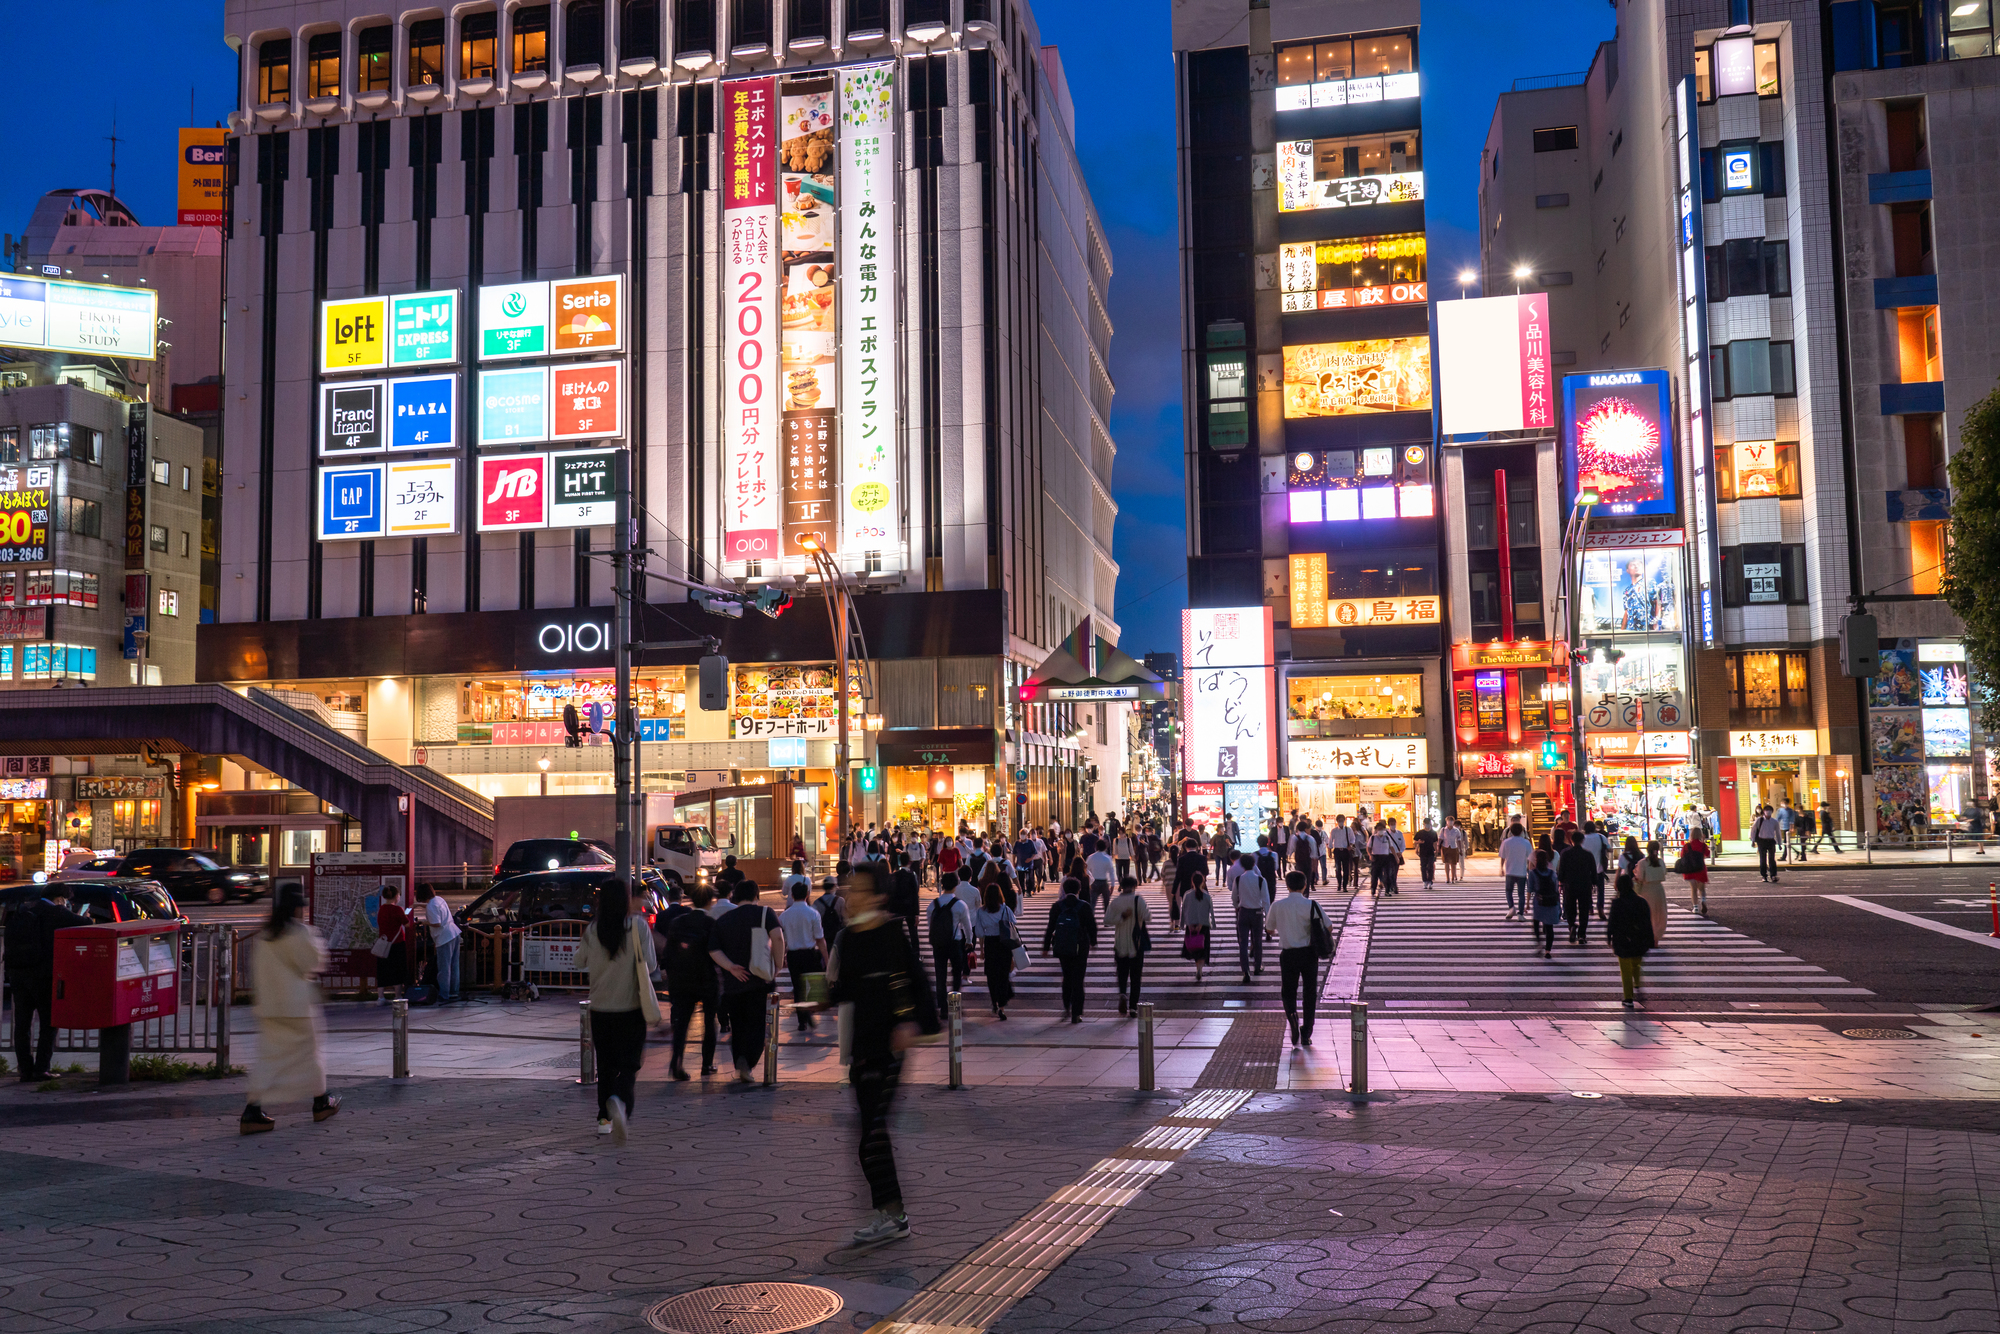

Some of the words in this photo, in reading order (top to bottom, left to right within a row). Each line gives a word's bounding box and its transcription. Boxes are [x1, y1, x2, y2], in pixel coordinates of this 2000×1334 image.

[733, 90, 750, 200] 年会費永年無料
[751, 89, 766, 198] エポスカード
[871, 137, 880, 155] 自然
[1296, 142, 1312, 152] 7F
[854, 138, 863, 168] 暮らす
[863, 137, 872, 197] エネルギーで
[731, 216, 743, 265] つかえる
[744, 215, 756, 266] 今日から
[757, 215, 769, 264] ご入会で
[859, 201, 878, 303] みんな電力
[562, 291, 611, 310] Seria
[79, 311, 122, 324] EIKOH
[397, 303, 450, 329] ニトリ
[78, 334, 121, 347] STUDY
[397, 330, 449, 347] EXPRESS
[496, 329, 532, 340] りそな銀行
[578, 333, 594, 345] 7F
[507, 339, 521, 351] 3F
[348, 353, 361, 363] 5F
[416, 347, 430, 358] 8F
[737, 271, 763, 445] 2000円分
[860, 316, 879, 439] エポスプラン
[1525, 323, 1548, 425] 品川美容外科
[1590, 373, 1642, 387] NAGATA
[562, 381, 610, 395] ほけんの
[485, 393, 541, 409] @cosme
[334, 408, 373, 421] Franc
[398, 402, 447, 416] PLAZA
[505, 424, 520, 435] B1
[578, 419, 594, 431] 3F
[345, 436, 361, 447] 4F
[414, 431, 429, 442] 4F
[789, 420, 800, 491] もっと楽しく
[803, 419, 814, 490] もっと快適に
[817, 418, 828, 489] 上野マルイは
[29, 469, 49, 486] 5F
[752, 450, 767, 508] クーポン
[406, 480, 434, 493] エース
[487, 467, 538, 504] JTB
[736, 451, 750, 524] プレゼント
[341, 488, 363, 506] GAP
[396, 492, 444, 505] コンタクト
[861, 490, 880, 498] カード
[857, 498, 884, 506] センター
[32, 510, 48, 523] 税込
[414, 510, 428, 521] 2F
[505, 510, 520, 522] 3F
[578, 506, 593, 517] 3F
[800, 503, 821, 520] 1F
[128, 489, 142, 556] もみの匠
[345, 520, 359, 531] 2F
[33, 528, 45, 545] 円
[855, 525, 886, 538] EPOS
[736, 537, 768, 553] OIOI
[1586, 533, 1673, 546] スポーツジュエン
[0, 547, 44, 561] 03-2646
[1745, 566, 1780, 576] テナント
[1293, 557, 1309, 625] 鉄板焼き餃子
[1752, 579, 1776, 590] 募集
[84, 594, 98, 602] RENT
[1368, 599, 1436, 622] 鳥福
[538, 622, 610, 653] OIOI
[1524, 654, 1541, 662] End
[1059, 688, 1128, 699] 上野御徒町中央通り
[1598, 692, 1673, 706] ようこそ
[1224, 671, 1261, 740] うどん
[740, 716, 764, 735] 9F
[766, 719, 828, 735] フードホール
[1595, 736, 1629, 749] LONDON
[1330, 745, 1394, 770] ねぎし
[1406, 743, 1417, 769] 2F
[717, 772, 728, 782] 1F
